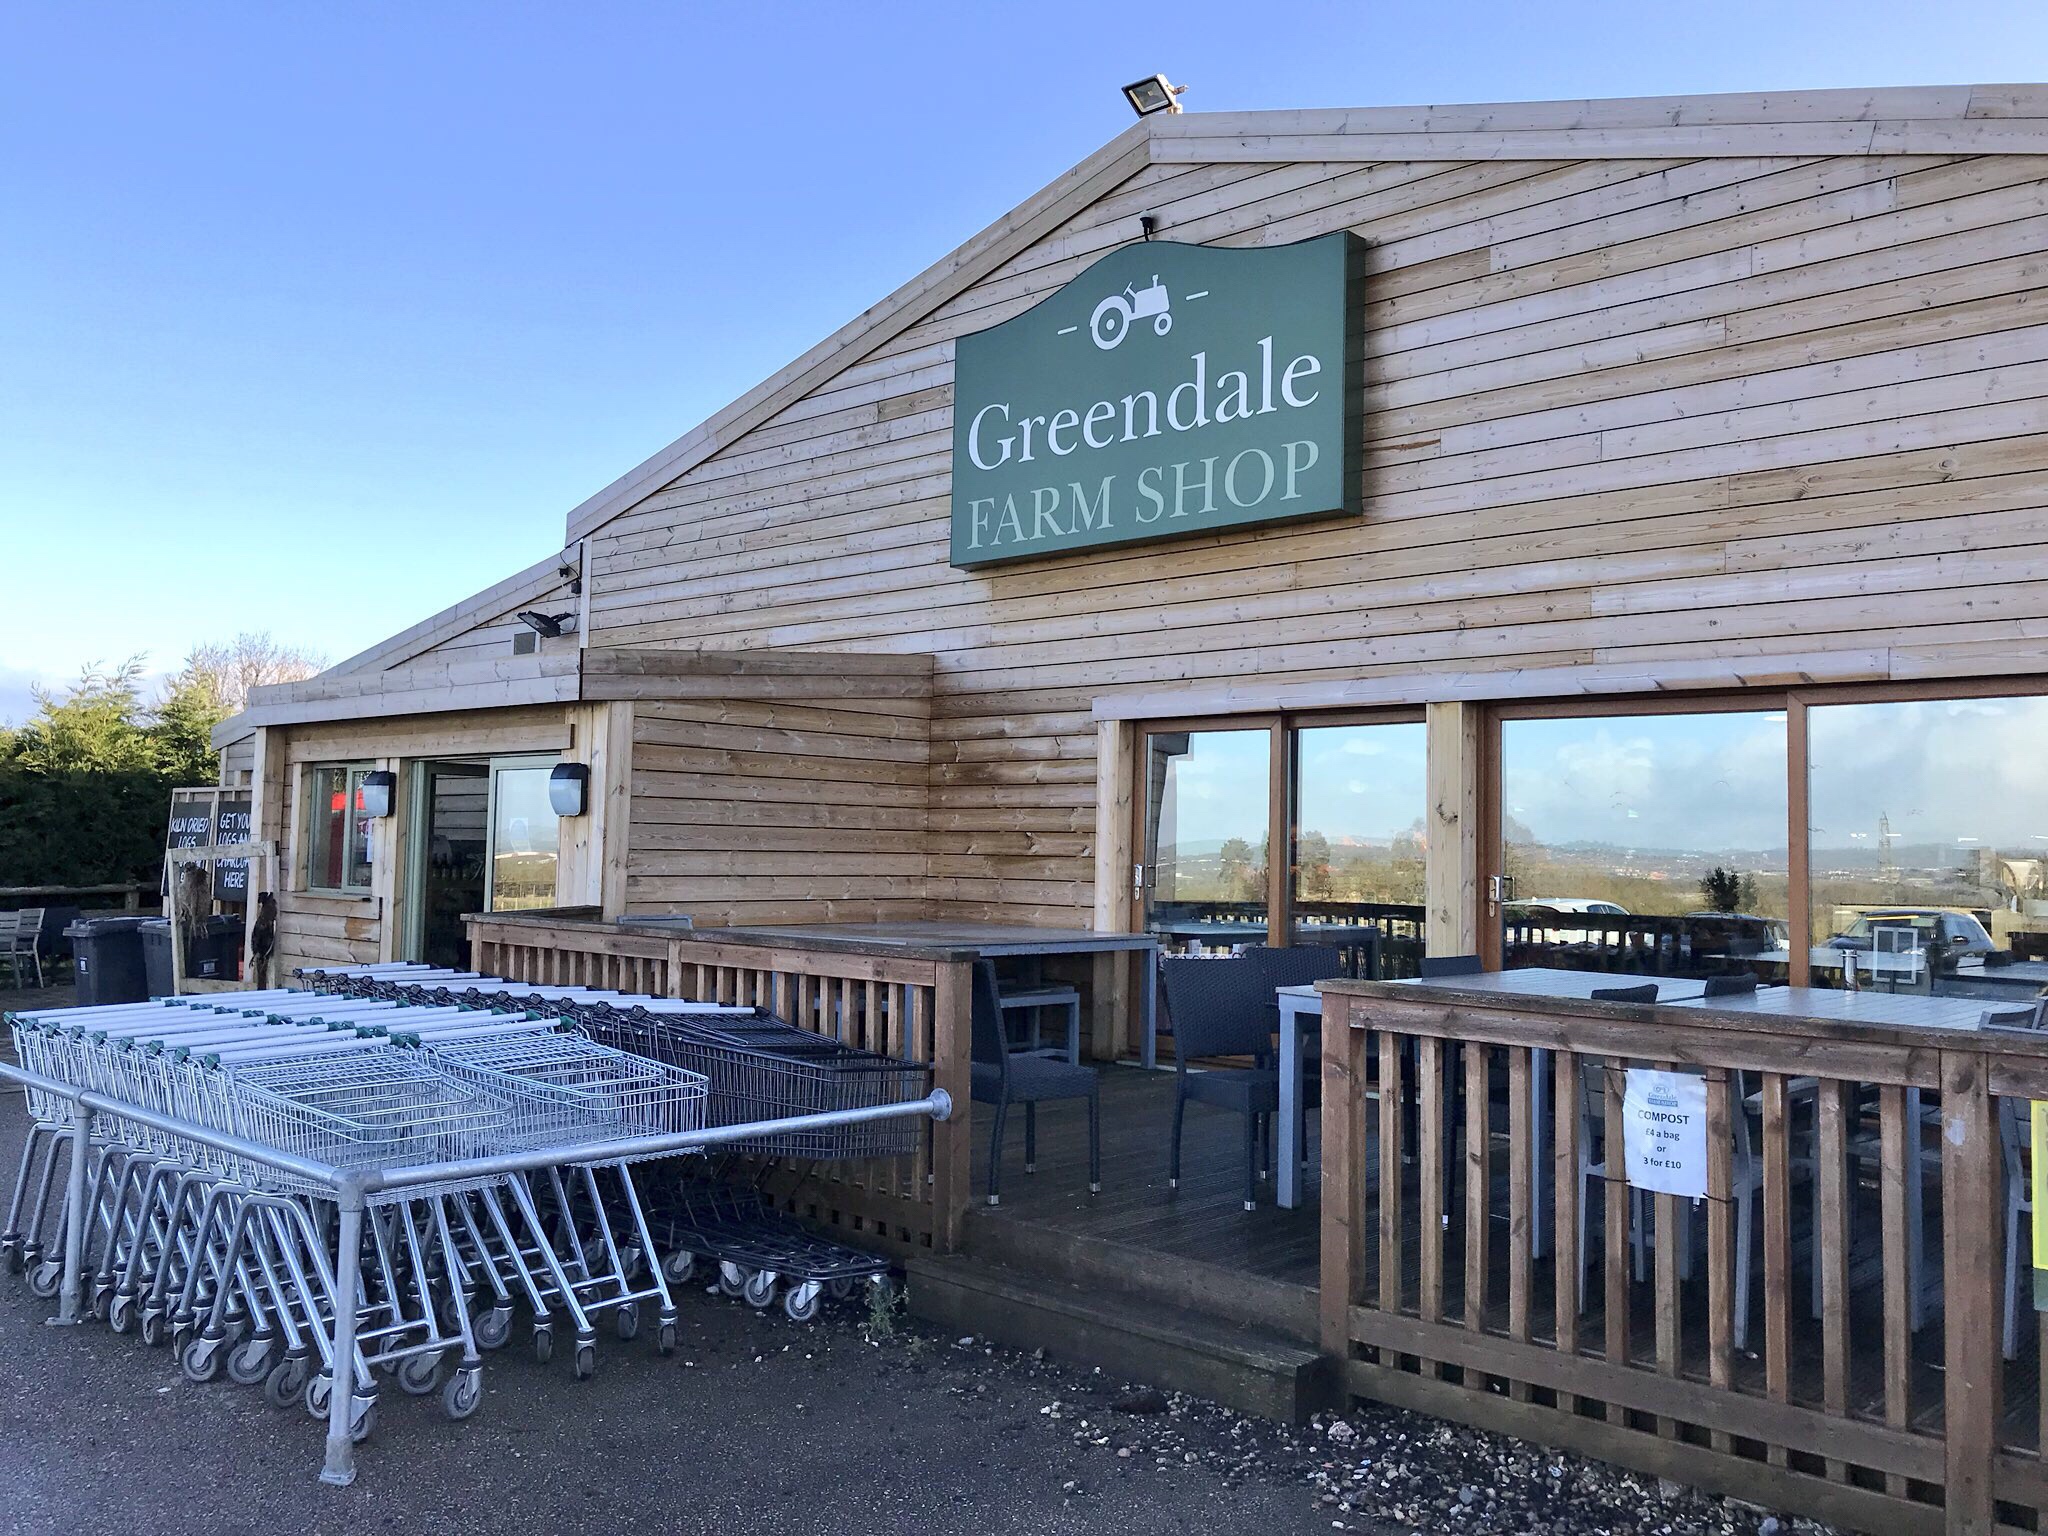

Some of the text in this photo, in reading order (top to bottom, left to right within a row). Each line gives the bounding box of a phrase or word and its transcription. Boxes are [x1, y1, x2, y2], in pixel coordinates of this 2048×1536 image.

[968, 336, 1321, 472] Greendale
[967, 440, 1320, 550] FARM SHOP
[170, 817, 209, 833] KILN DRIED
[220, 813, 251, 829] GET YOU
[177, 836, 197, 849] LOGS
[218, 832, 251, 846] LOGS AN
[216, 857, 250, 868] CHARCOA
[223, 871, 245, 888] HERE
[1637, 1109, 1690, 1125] COMPOST
[1645, 1128, 1655, 1137] £4
[1663, 1130, 1680, 1141] bag
[1656, 1145, 1666, 1153] or
[1643, 1157, 1682, 1169] 3 for £10
